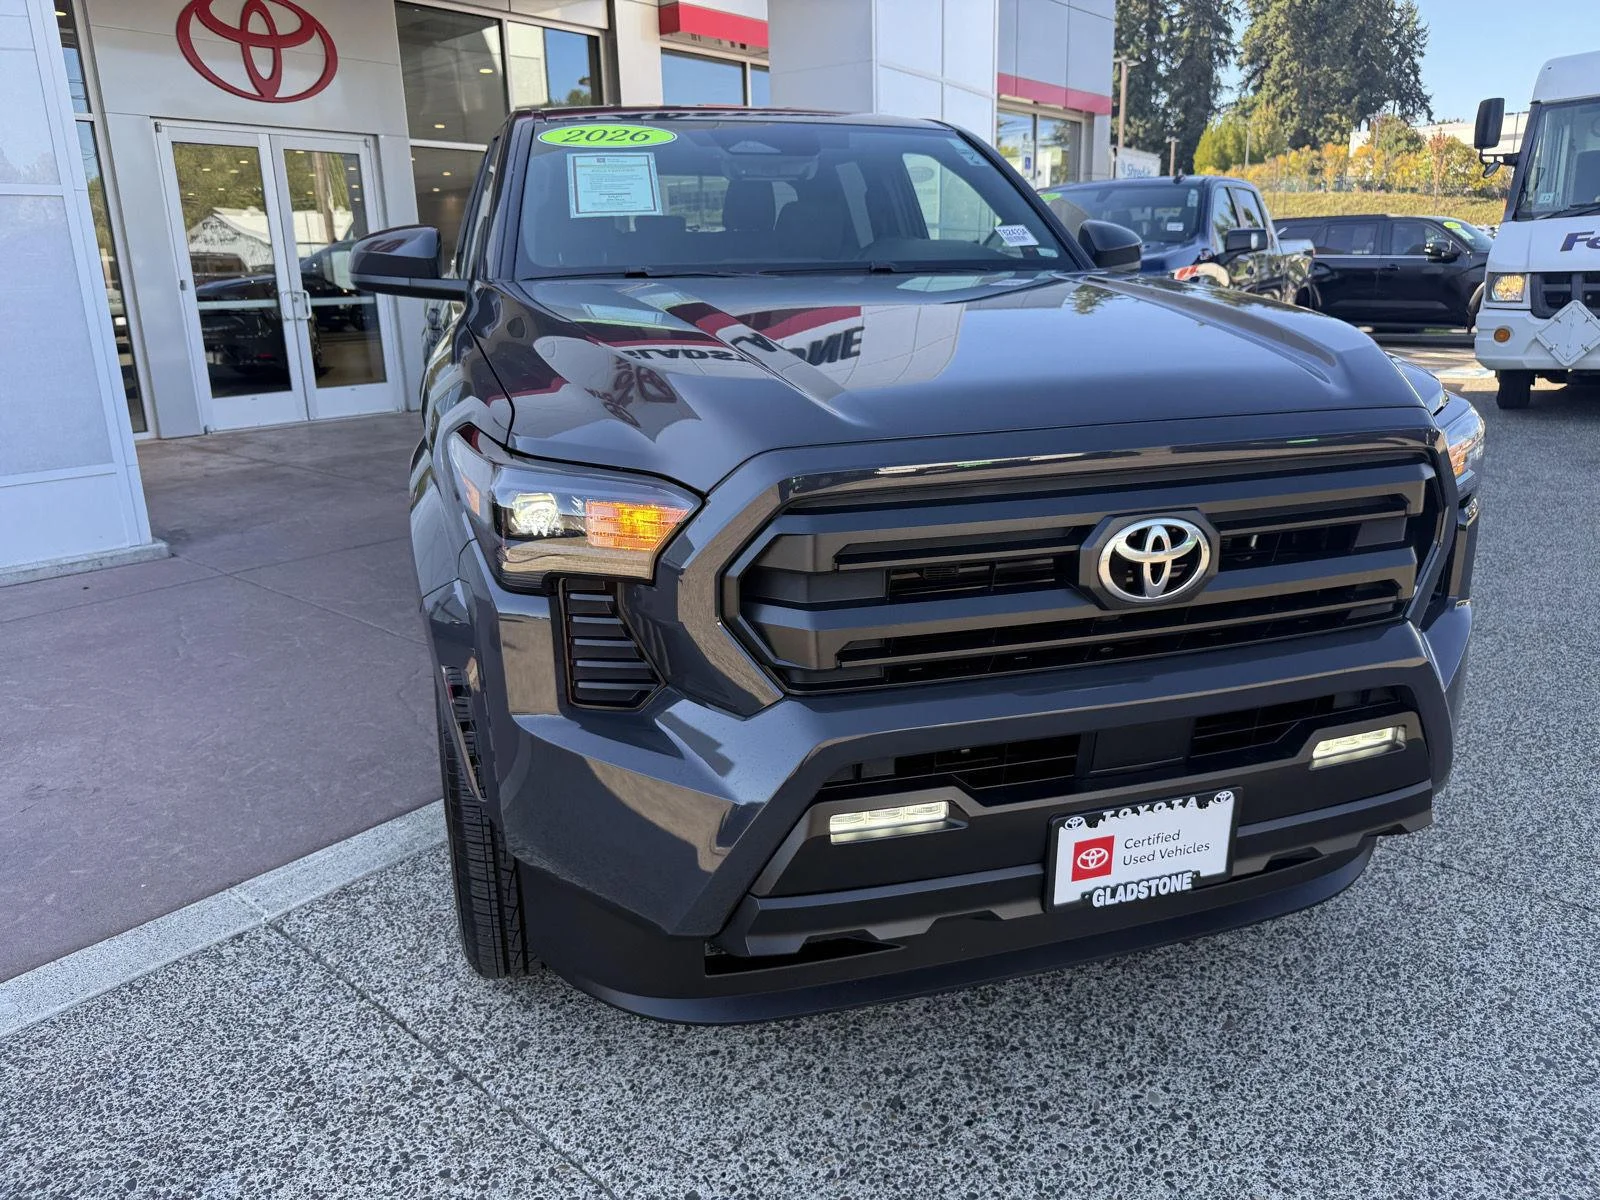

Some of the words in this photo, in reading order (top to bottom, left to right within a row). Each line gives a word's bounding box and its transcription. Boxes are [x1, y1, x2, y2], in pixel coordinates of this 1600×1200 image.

[561, 129, 652, 142] 2026
[1103, 796, 1199, 822] TOYOTA
[1124, 829, 1181, 850] Certified
[1123, 851, 1155, 866] Used
[1160, 841, 1210, 859] Vehicles
[1092, 871, 1193, 908] GLADSTONE
